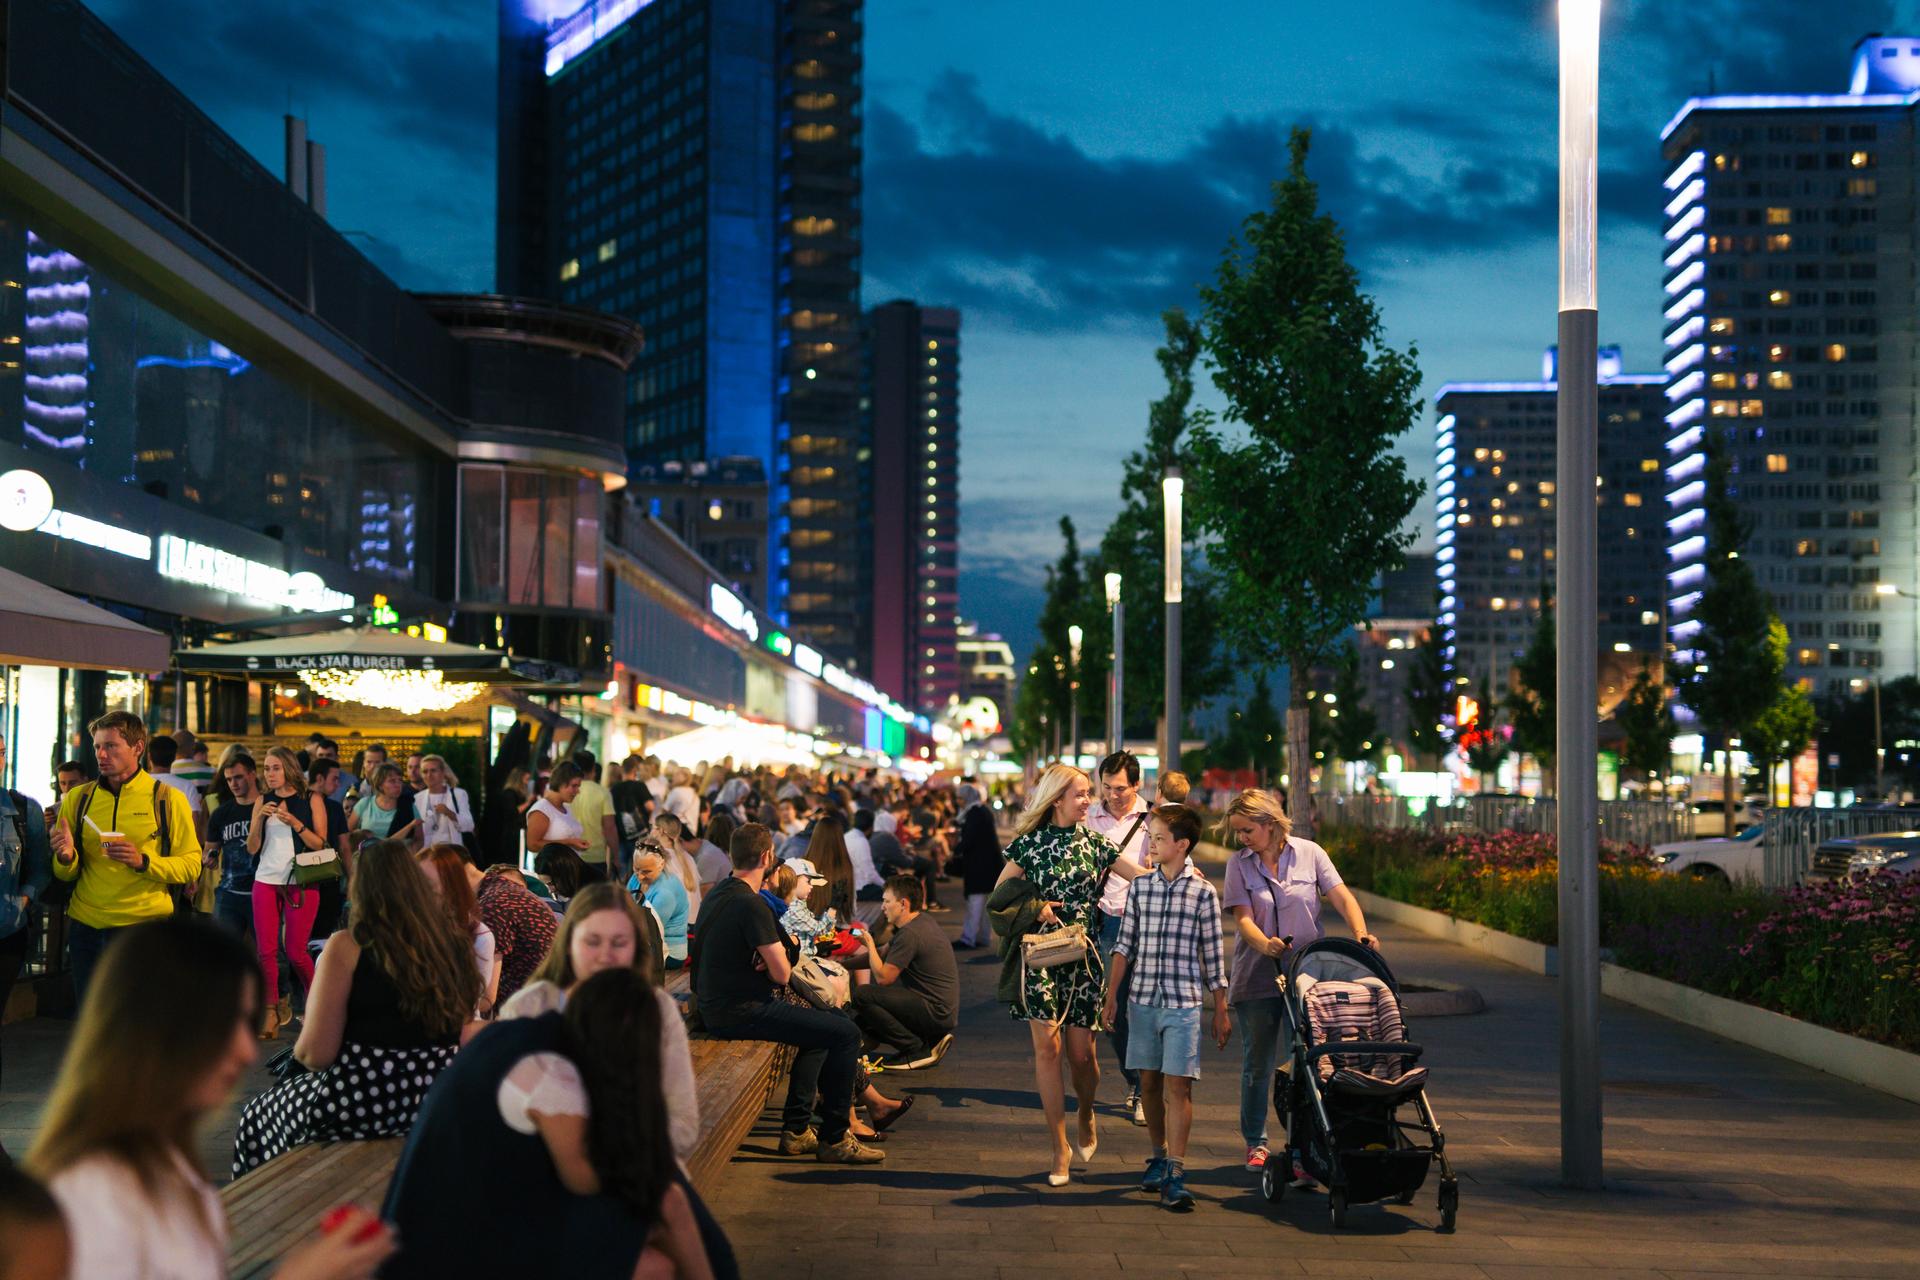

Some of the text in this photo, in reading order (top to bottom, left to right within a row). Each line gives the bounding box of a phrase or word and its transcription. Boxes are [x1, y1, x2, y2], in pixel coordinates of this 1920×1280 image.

[275, 654, 406, 670] BLACK STAR BURGER
[222, 820, 250, 842] NICK
